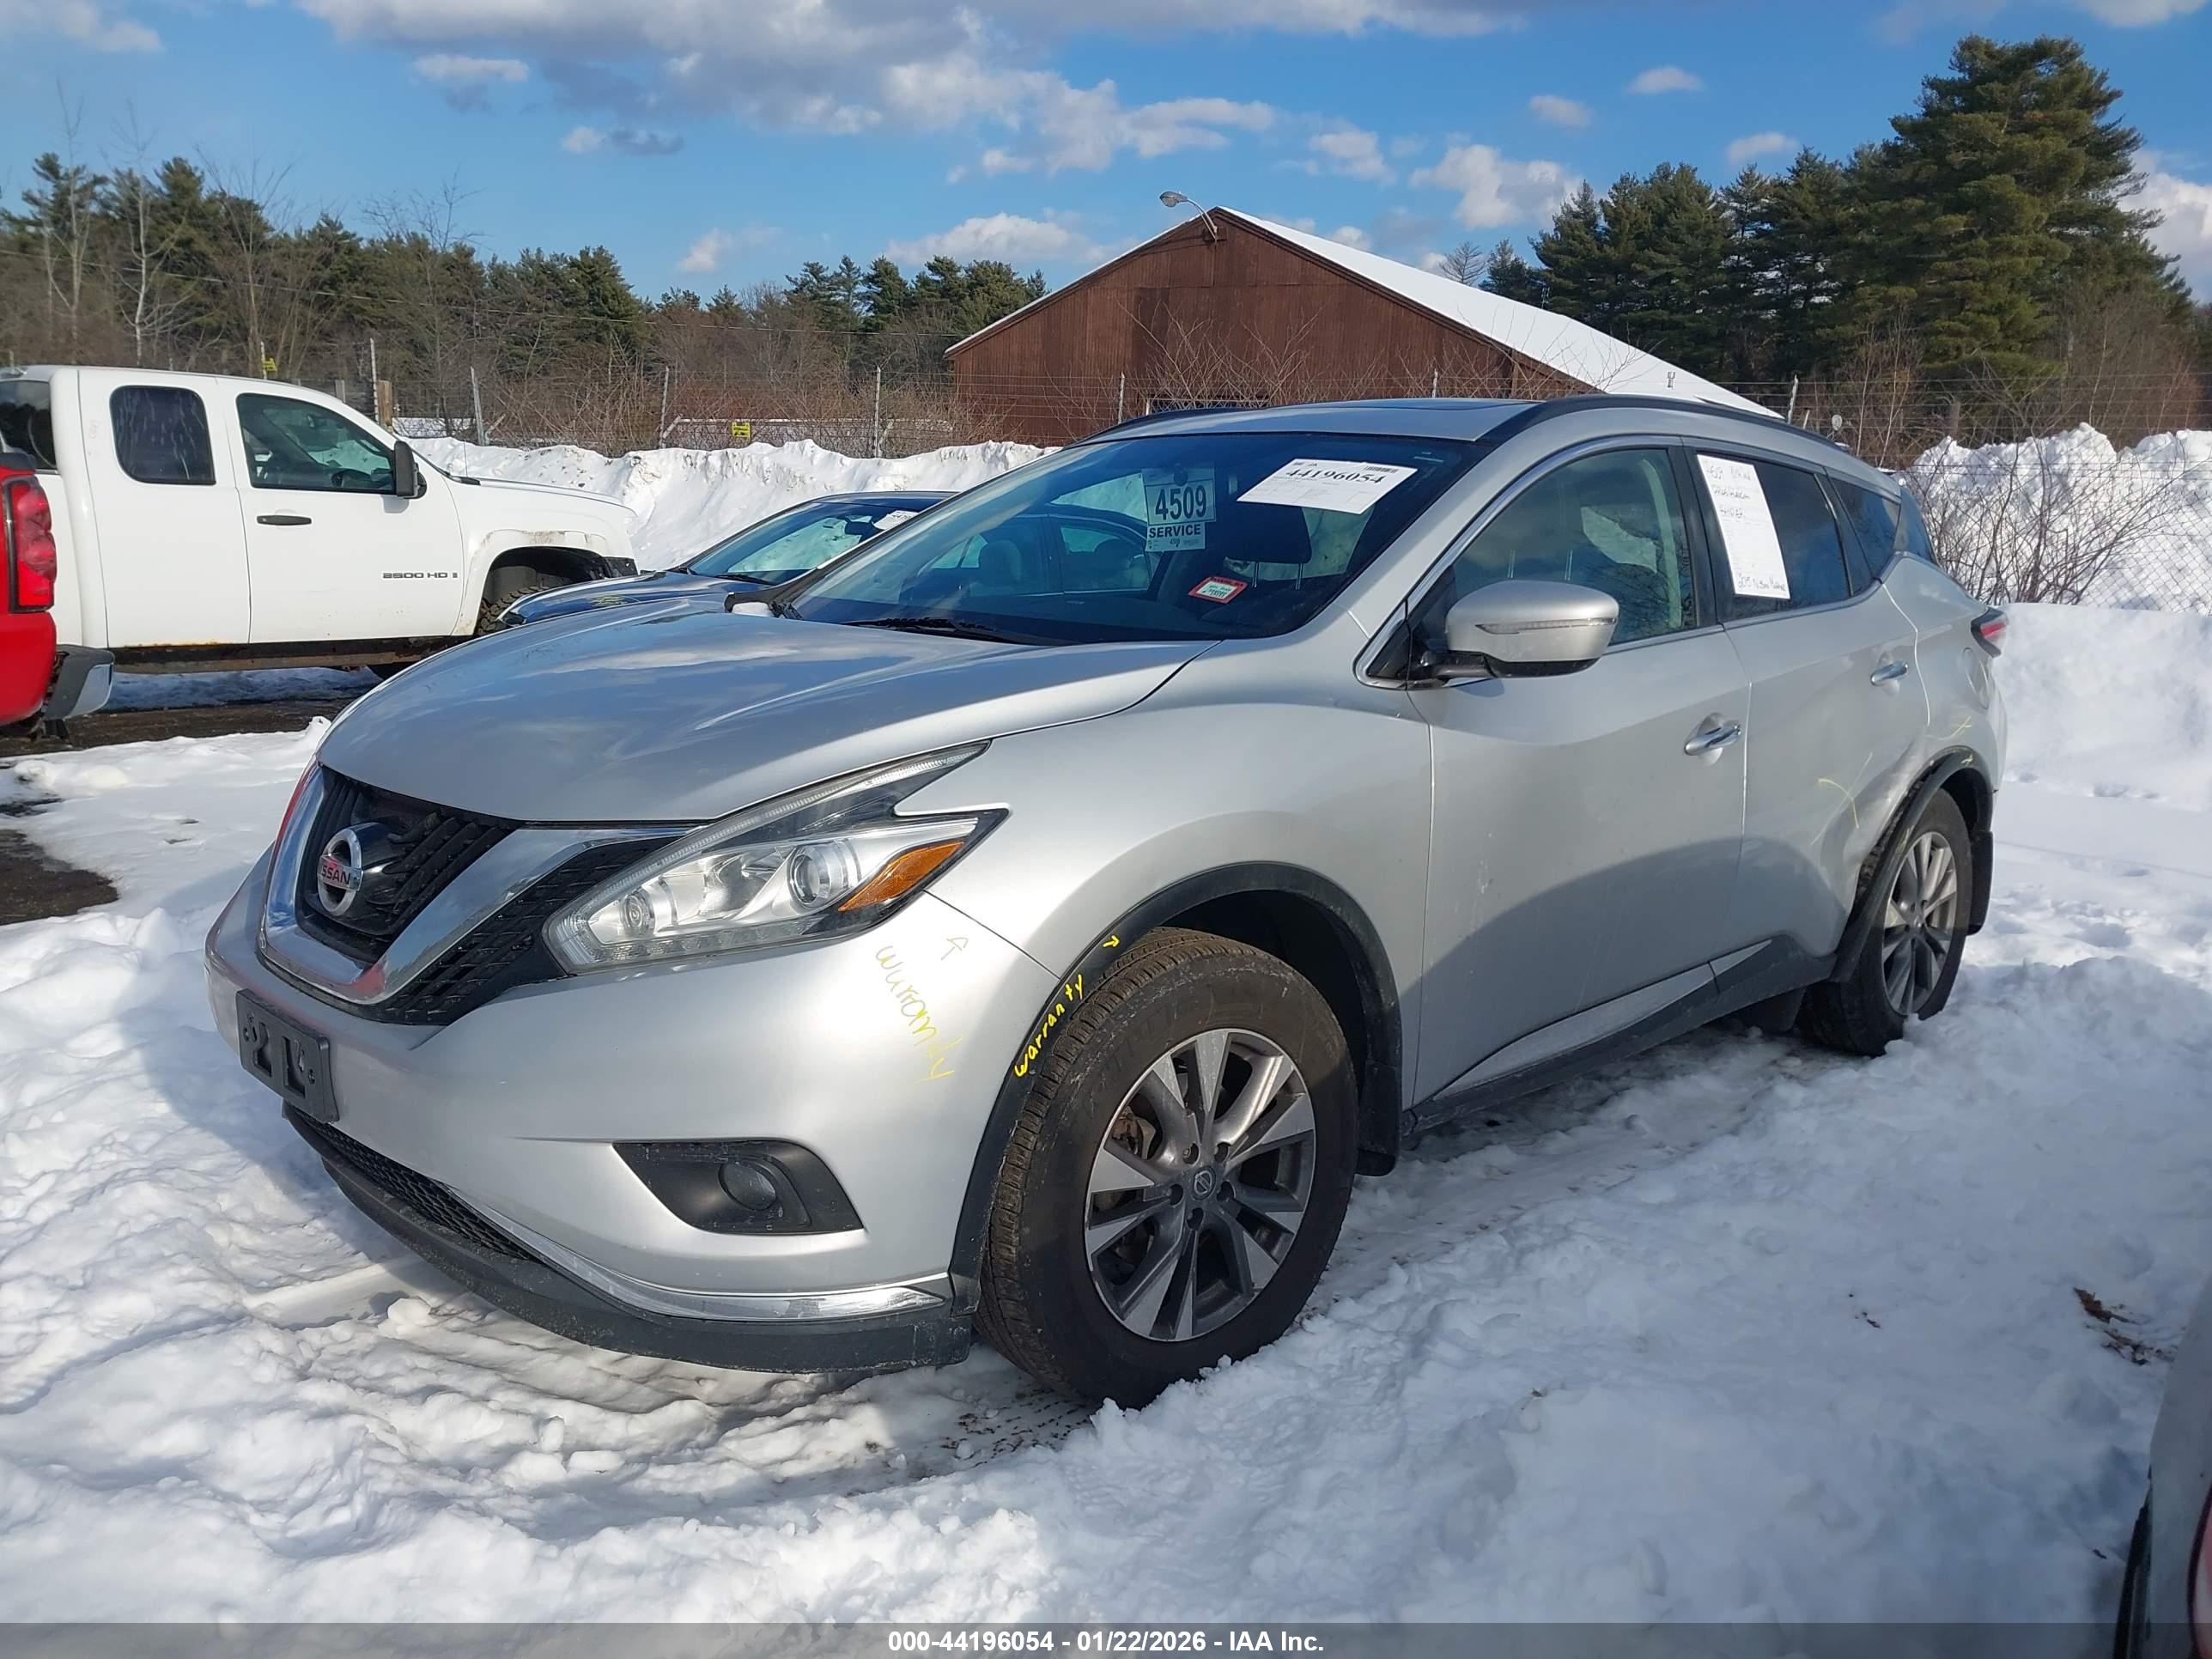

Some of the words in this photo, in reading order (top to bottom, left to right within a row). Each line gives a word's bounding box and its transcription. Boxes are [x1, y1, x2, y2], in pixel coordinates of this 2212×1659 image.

[1286, 469, 1388, 484] 44196054
[1155, 485, 1207, 520] 4509
[1148, 524, 1201, 538] SERVICE
[1014, 974, 1084, 1078] warranty
